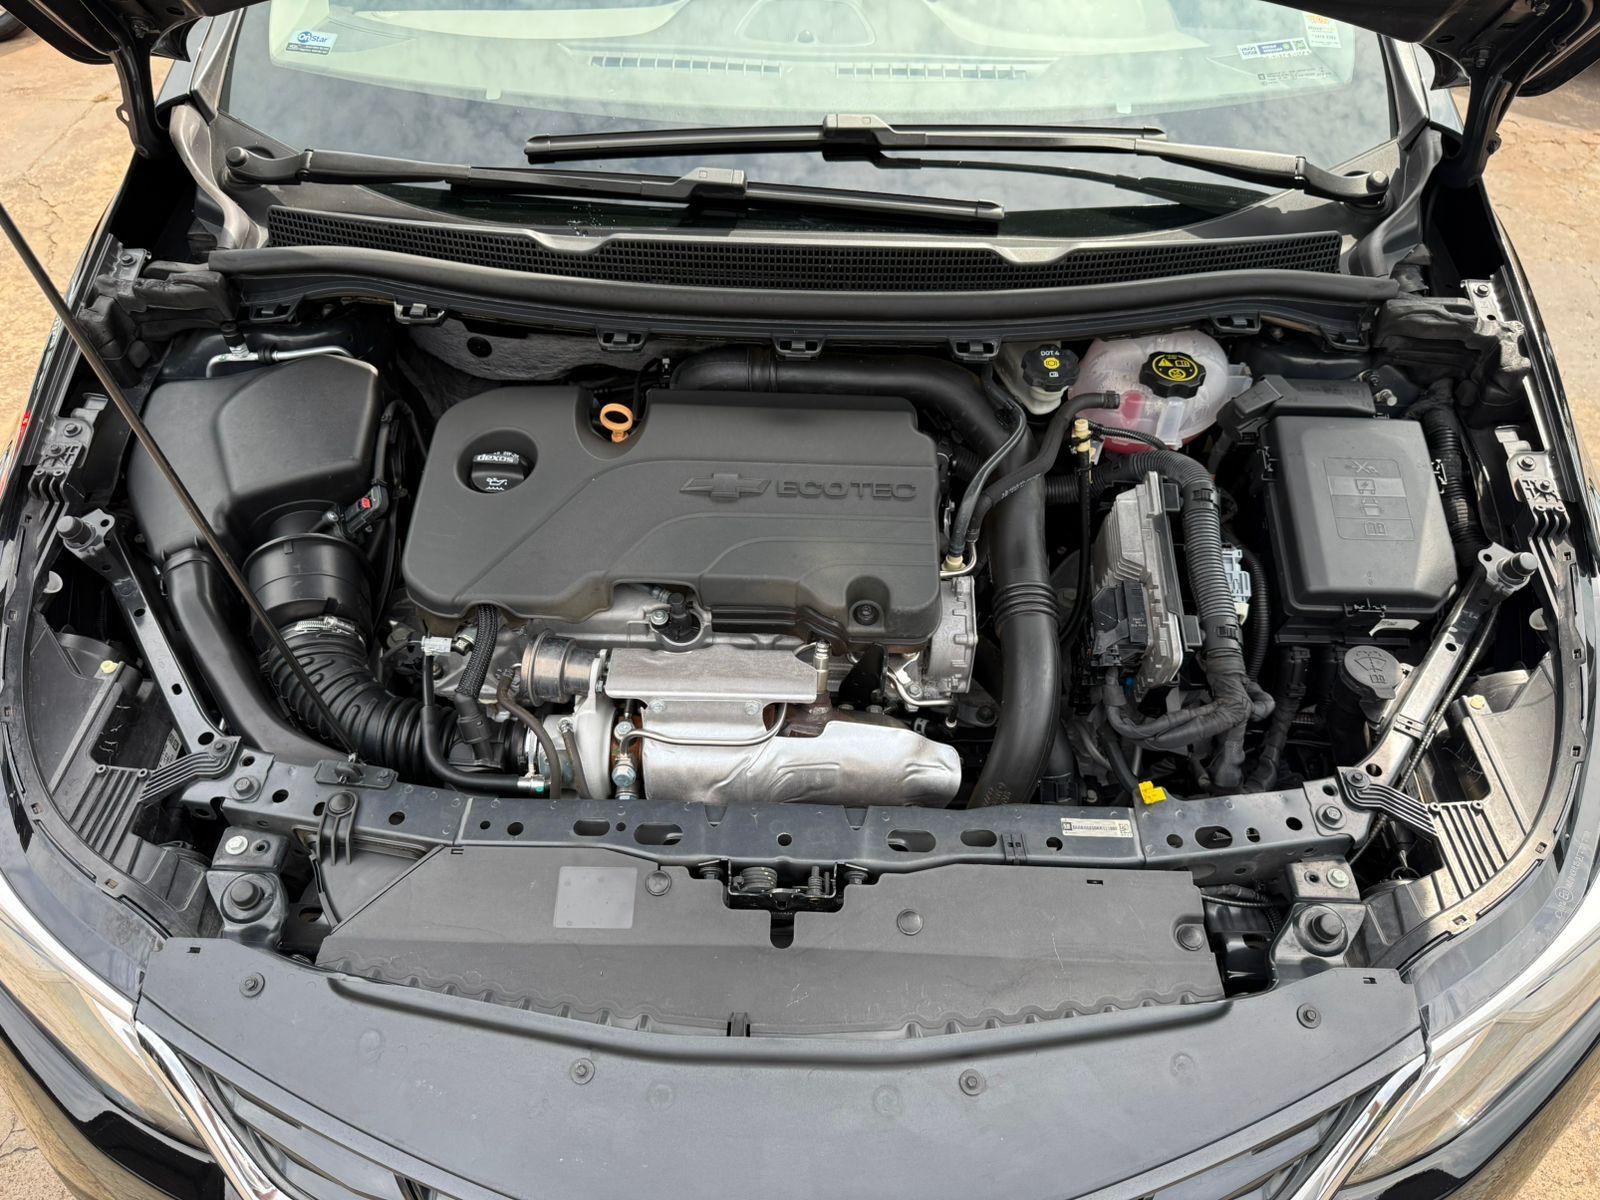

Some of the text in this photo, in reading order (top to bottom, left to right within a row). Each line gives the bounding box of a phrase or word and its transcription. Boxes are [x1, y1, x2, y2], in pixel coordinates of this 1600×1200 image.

[298, 32, 328, 43] OnStar
[476, 454, 514, 462] dexos
[776, 480, 917, 500] ECOTEC
